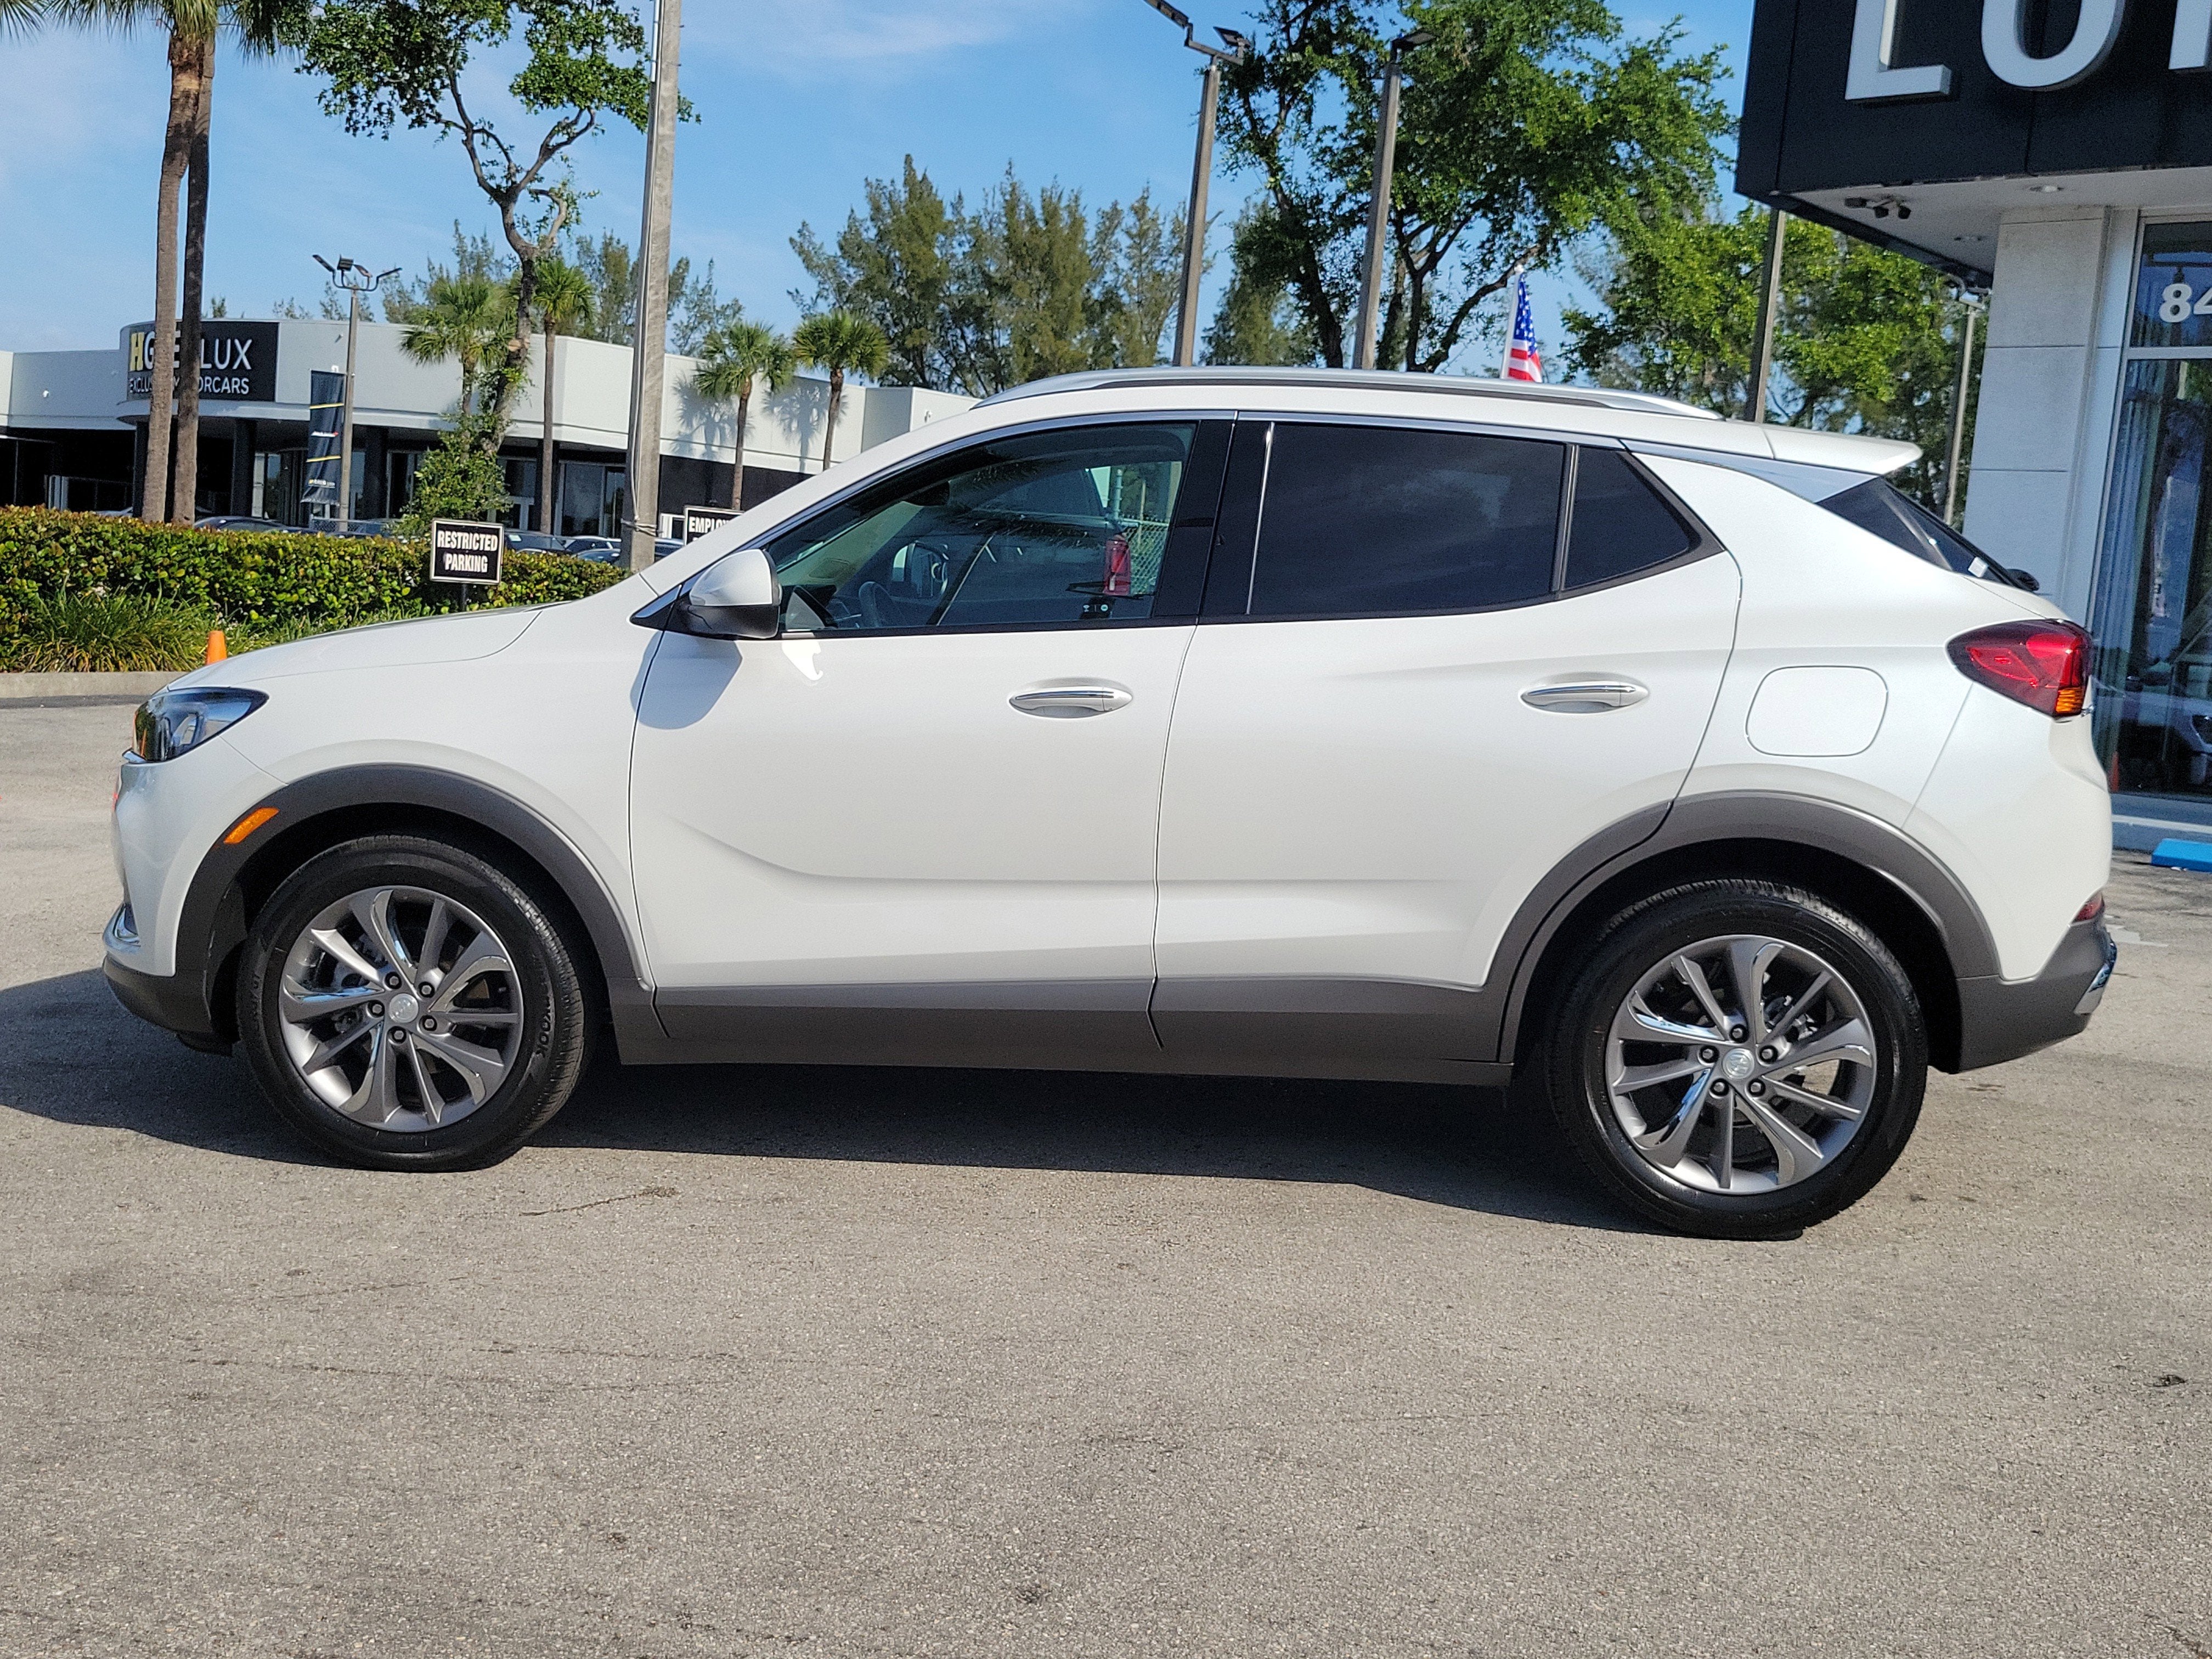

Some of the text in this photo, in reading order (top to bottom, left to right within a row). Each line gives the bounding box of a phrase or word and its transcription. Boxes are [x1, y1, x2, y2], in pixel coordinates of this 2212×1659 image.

[200, 338, 252, 370] LUX
[437, 530, 498, 551] RESTRICTED
[445, 553, 488, 573] PARKING
